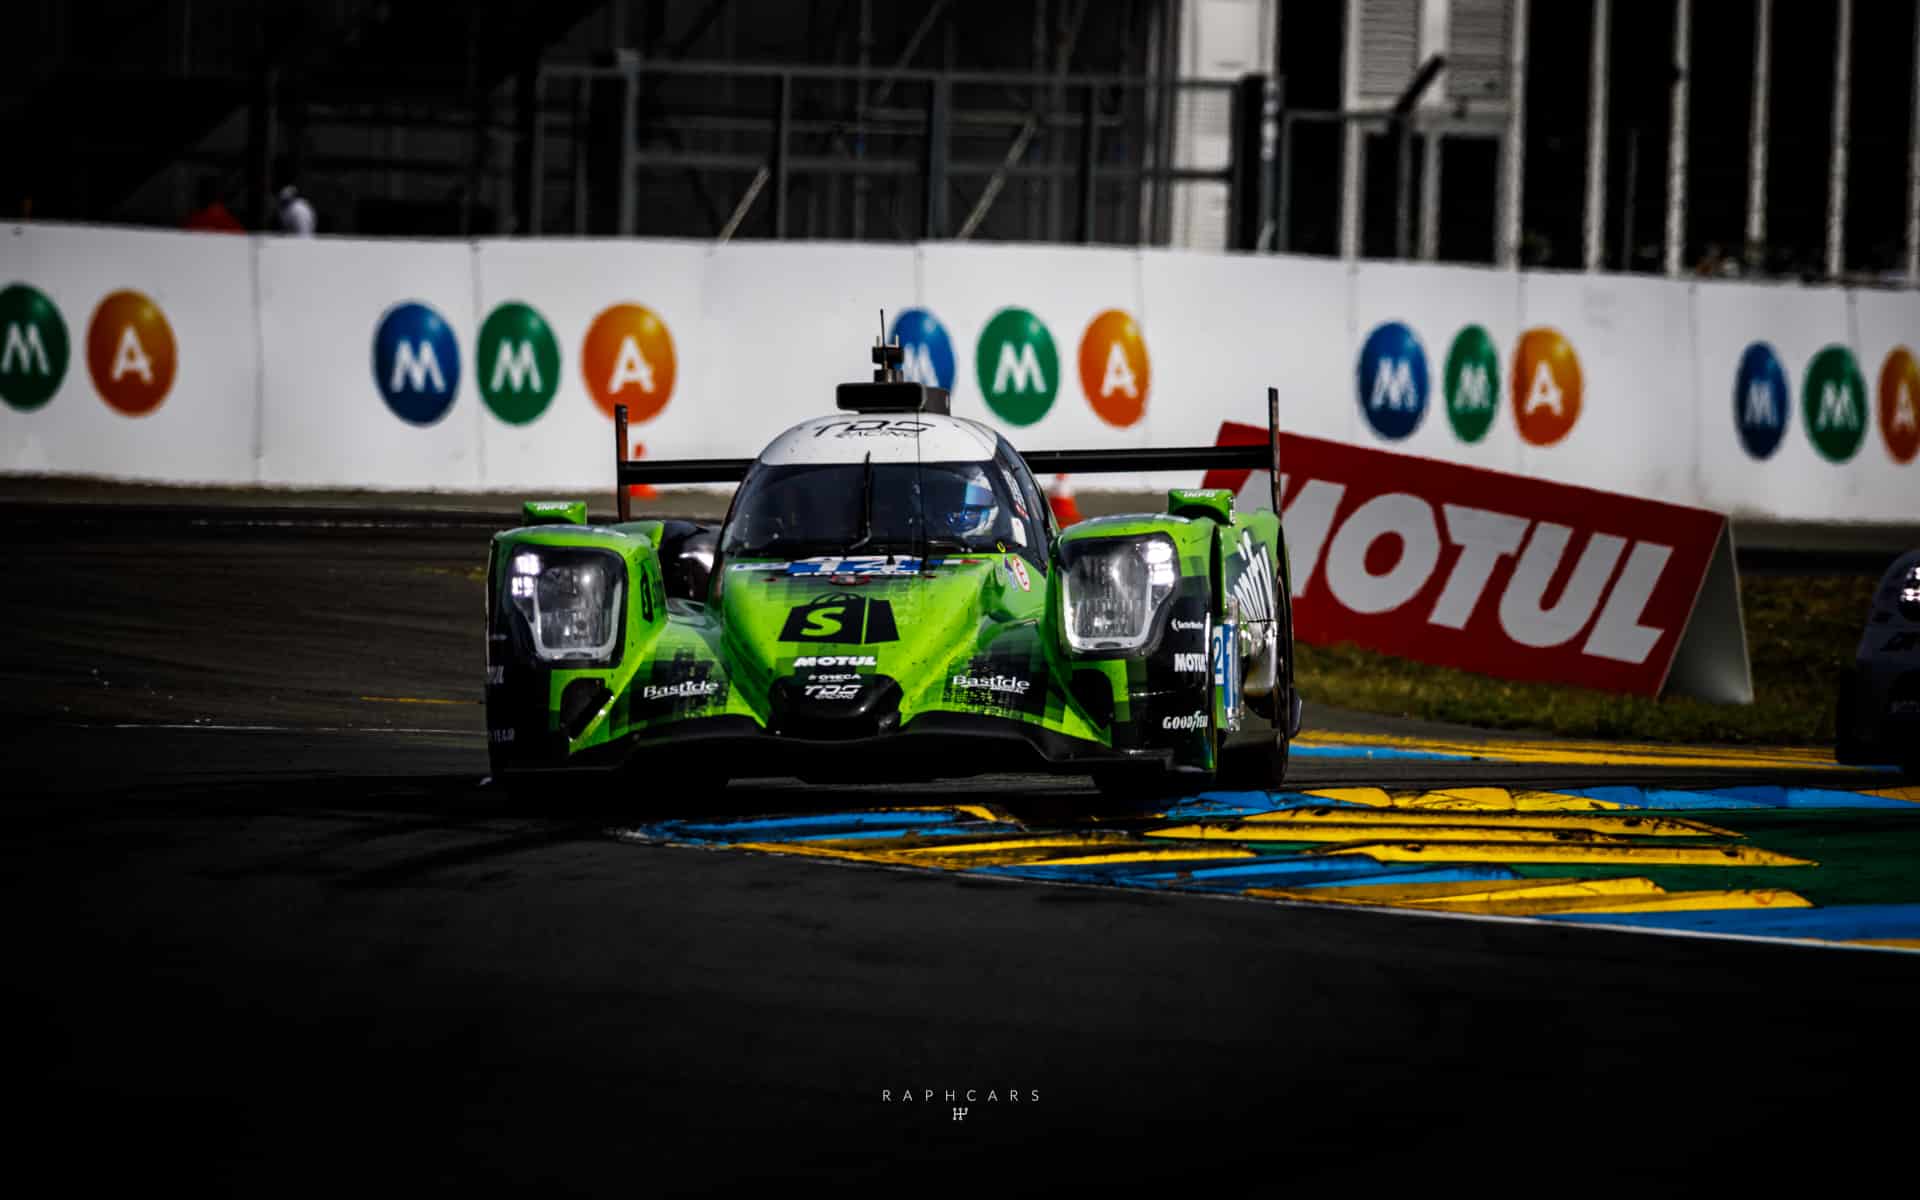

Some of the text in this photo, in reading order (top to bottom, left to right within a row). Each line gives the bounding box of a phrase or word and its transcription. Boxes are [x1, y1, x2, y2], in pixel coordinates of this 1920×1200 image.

[1234, 470, 1674, 664] MOTUL
[793, 656, 877, 667] MOTUL
[1174, 653, 1208, 673] MOTU
[643, 680, 719, 699] Bastide
[952, 674, 1031, 690] Bastide
